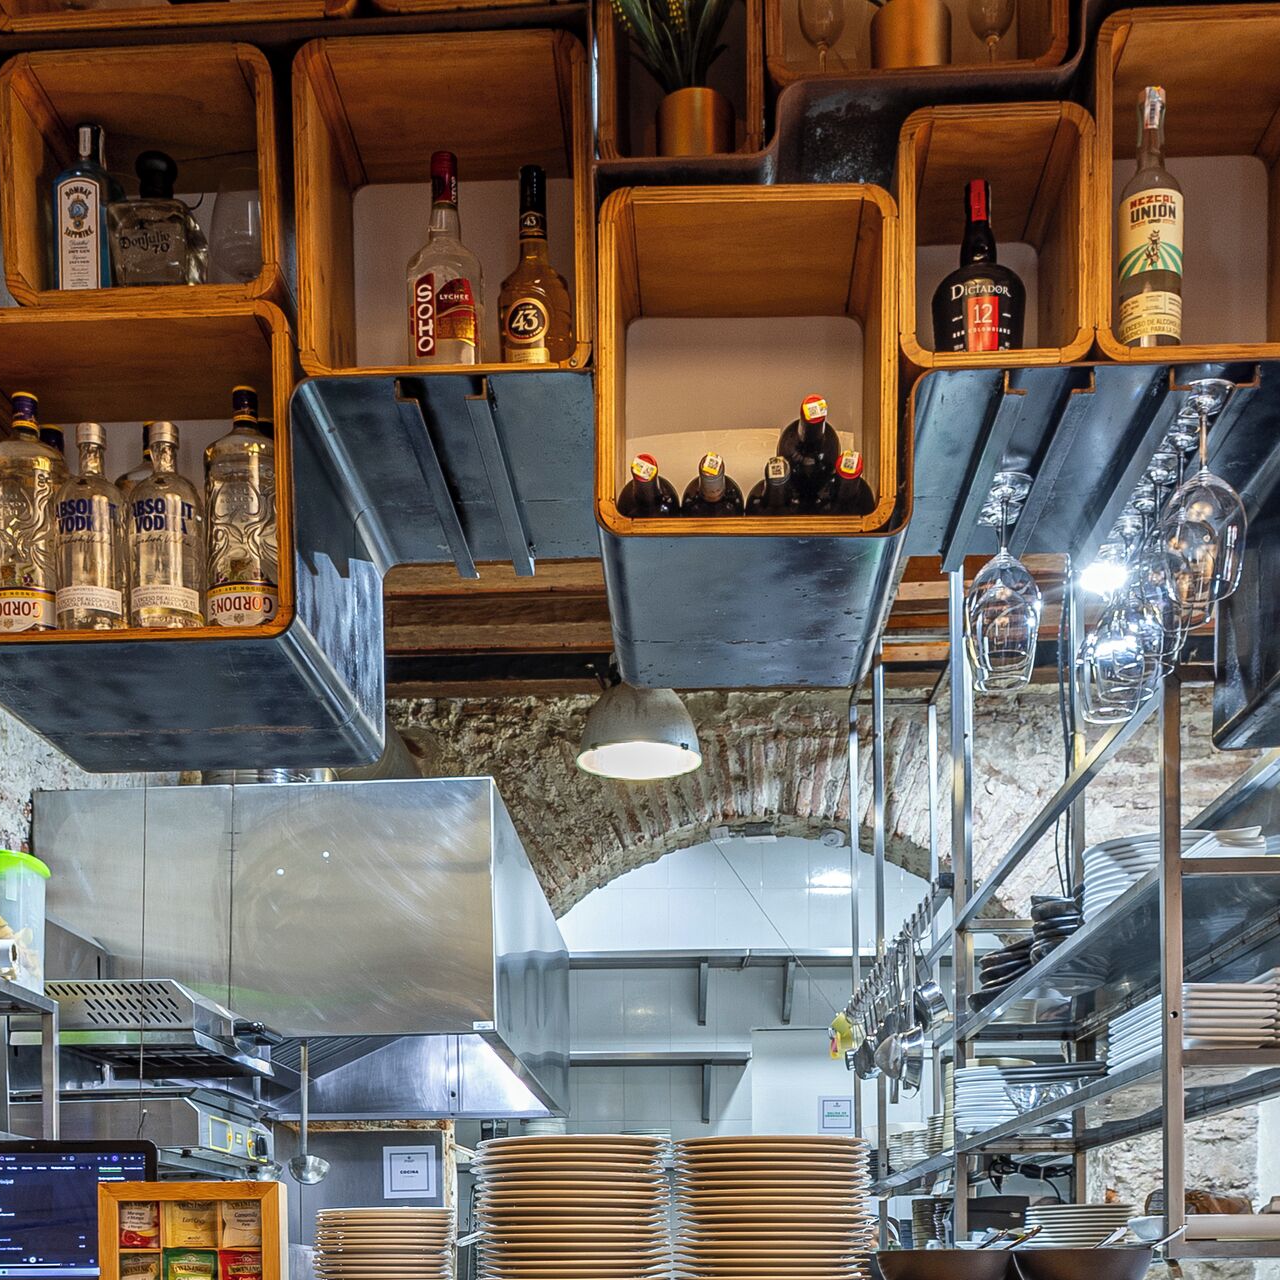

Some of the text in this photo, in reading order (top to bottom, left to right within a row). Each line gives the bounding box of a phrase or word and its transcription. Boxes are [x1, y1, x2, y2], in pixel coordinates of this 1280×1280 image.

[64, 186, 92, 199] BOMBAY
[524, 216, 537, 226] 43
[439, 293, 470, 301] LYCHEE
[417, 284, 435, 352] SOHO
[511, 309, 539, 331] 43
[973, 303, 993, 324] 12
[135, 515, 187, 534] VODA
[211, 596, 273, 616] GORDON'S
